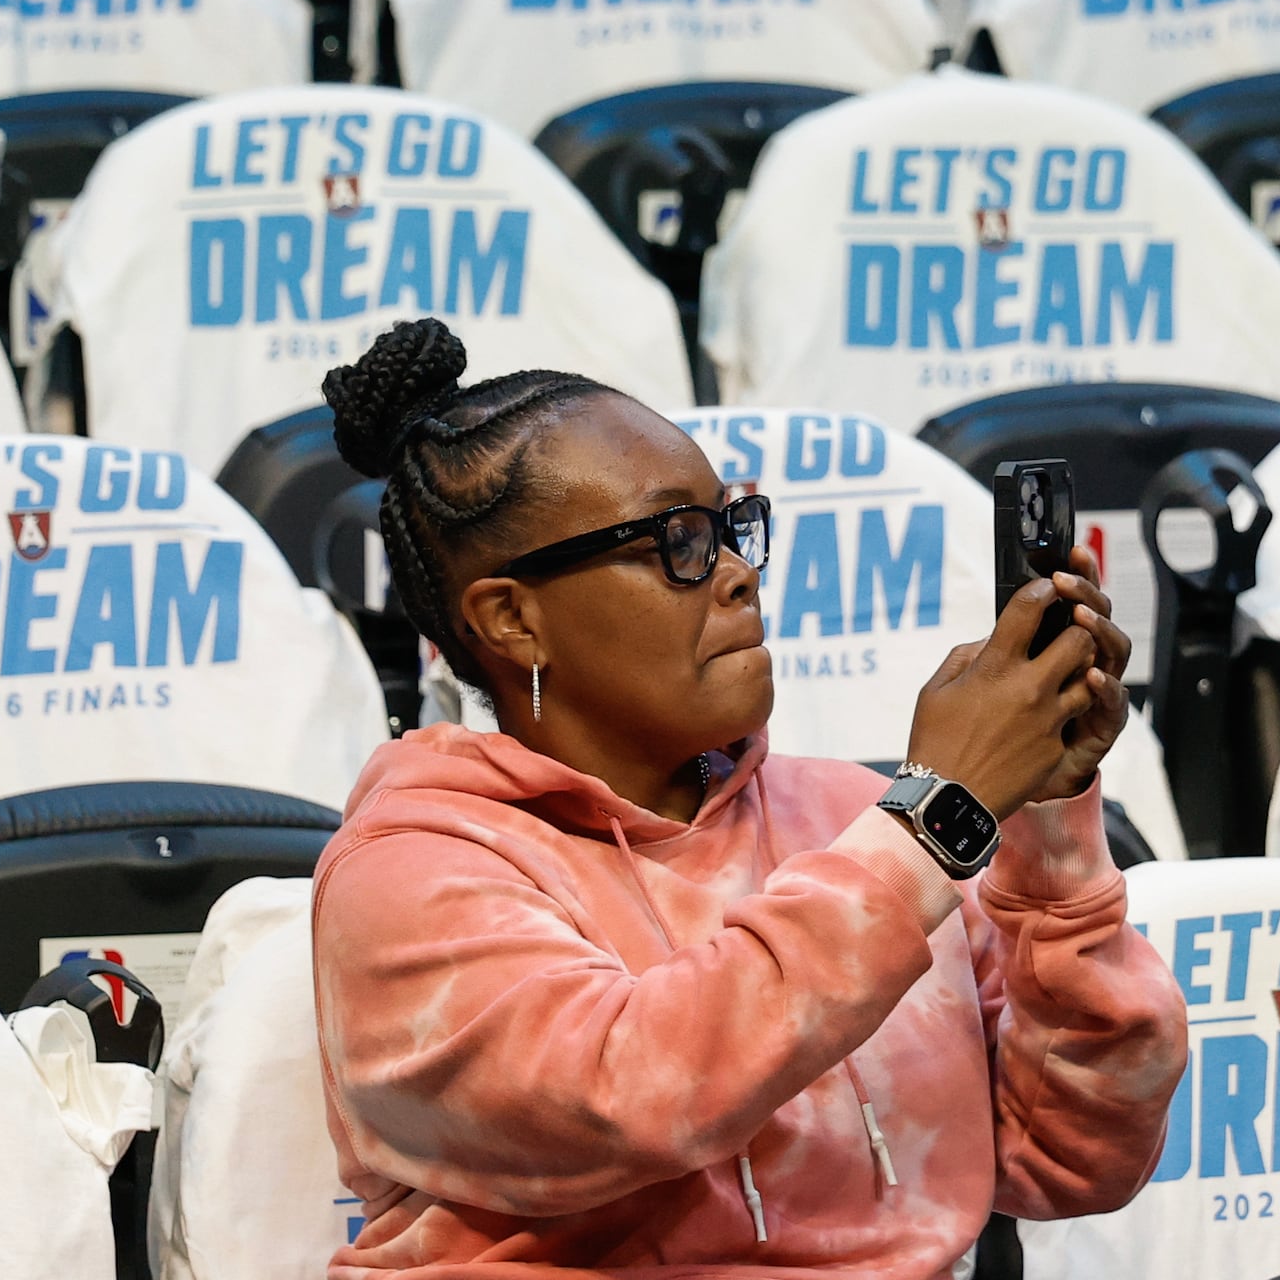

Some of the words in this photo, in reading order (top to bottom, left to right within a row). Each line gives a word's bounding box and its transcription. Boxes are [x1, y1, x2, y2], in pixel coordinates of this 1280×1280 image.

[193, 114, 369, 188] LET'S
[387, 114, 482, 178] GO
[852, 149, 1017, 213] LET'S
[1035, 148, 1126, 213] GO
[190, 206, 529, 327] DREAM
[846, 241, 1174, 350] DREAM
[80, 447, 186, 513] GO
[784, 415, 887, 482] GO
[781, 649, 878, 678] INALS
[43, 684, 171, 715] FINALS
[154, 836, 172, 857] 2
